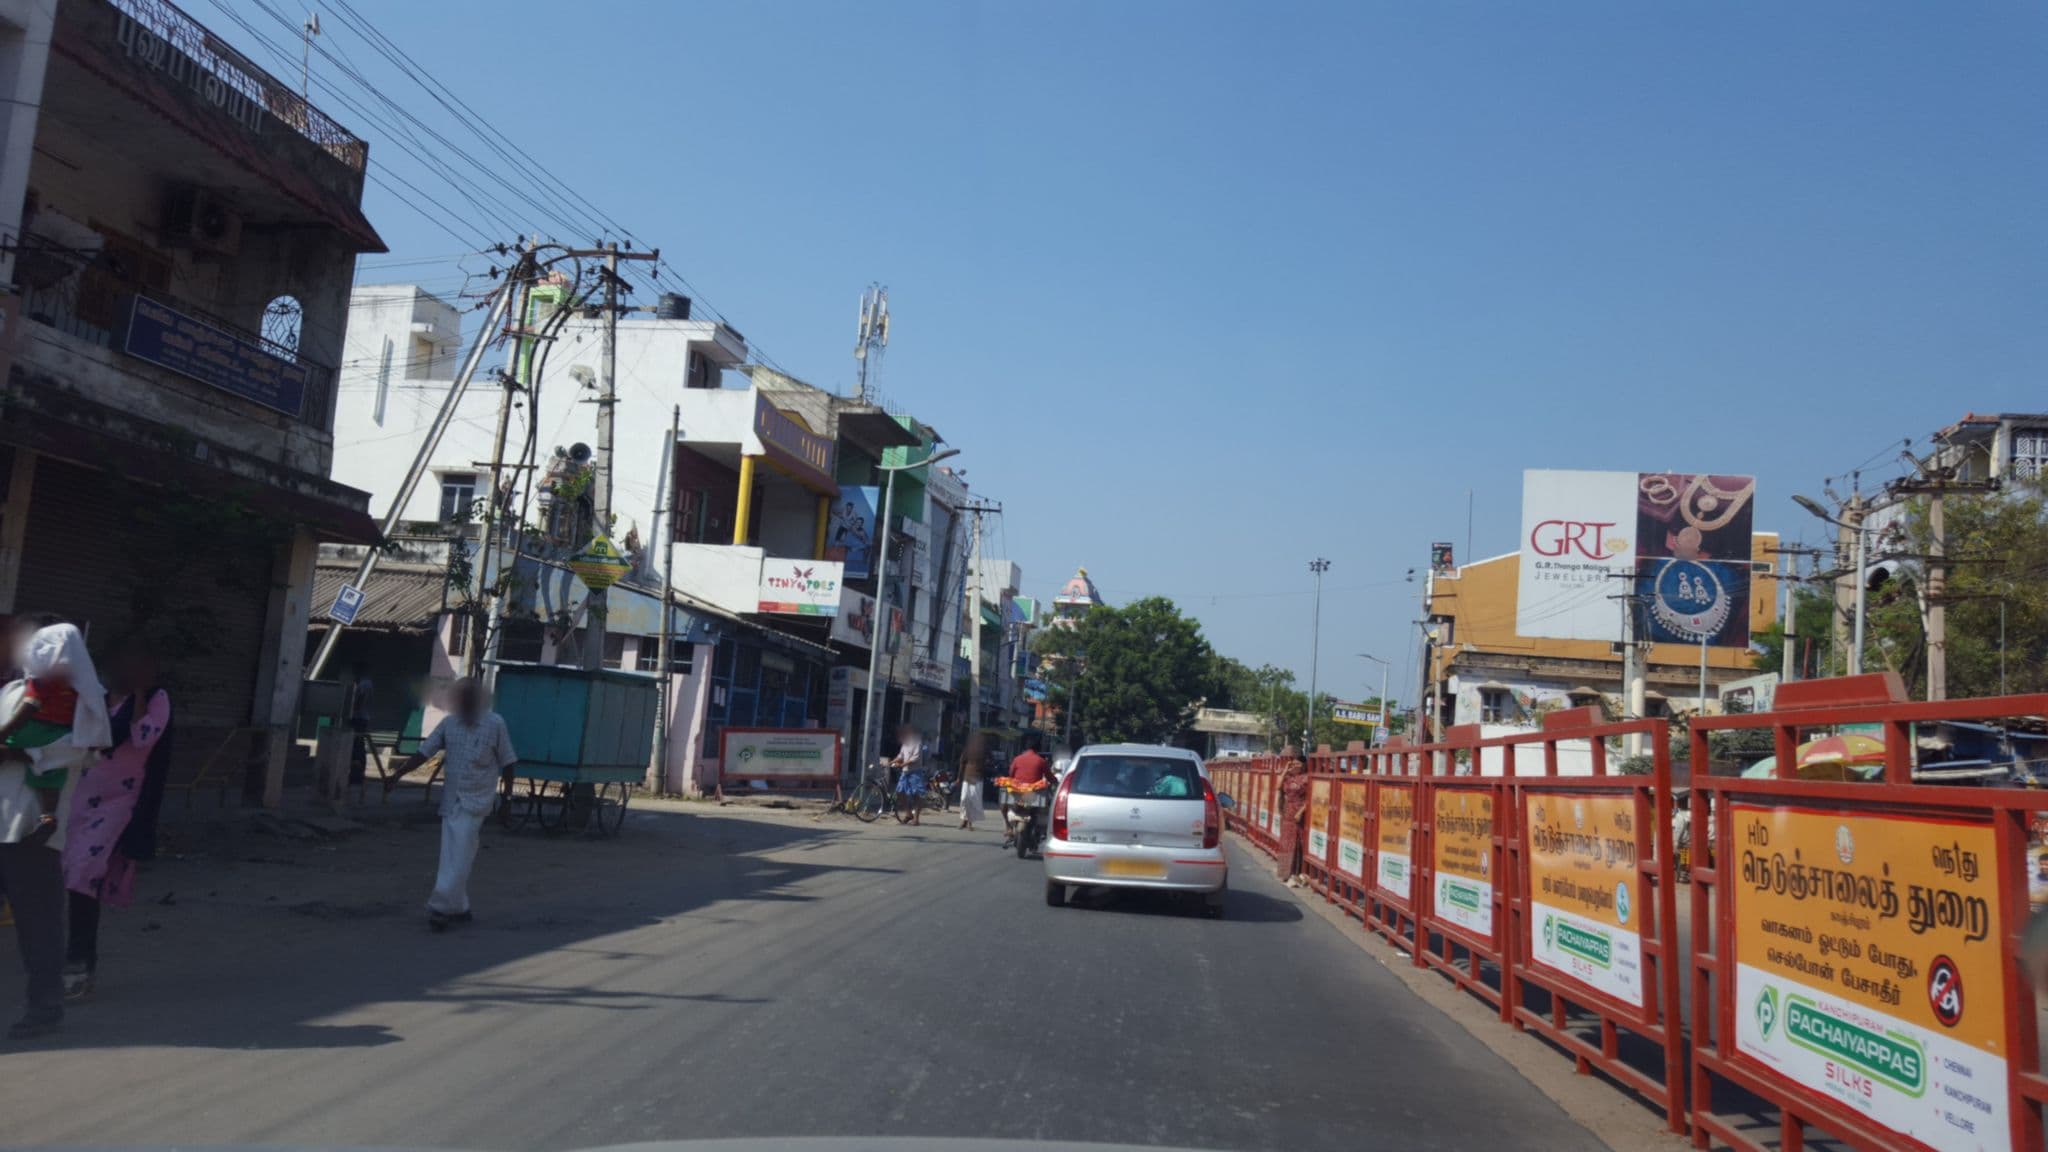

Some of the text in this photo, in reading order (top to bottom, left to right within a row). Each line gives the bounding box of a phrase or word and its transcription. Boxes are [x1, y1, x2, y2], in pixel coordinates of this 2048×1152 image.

[1531, 519, 1616, 560] GRT
[768, 577, 835, 591] TINY TOES
[1534, 571, 1609, 582] JEWELLERS
[1742, 849, 1989, 944] நெடுஞ்சாலைத் துறை
[1761, 919, 1813, 944] வாகனம்
[1767, 947, 1835, 981] செல்போன்
[1790, 1008, 1917, 1079] PACHAIYAPPAS
[1826, 1061, 1873, 1098] SILKS
